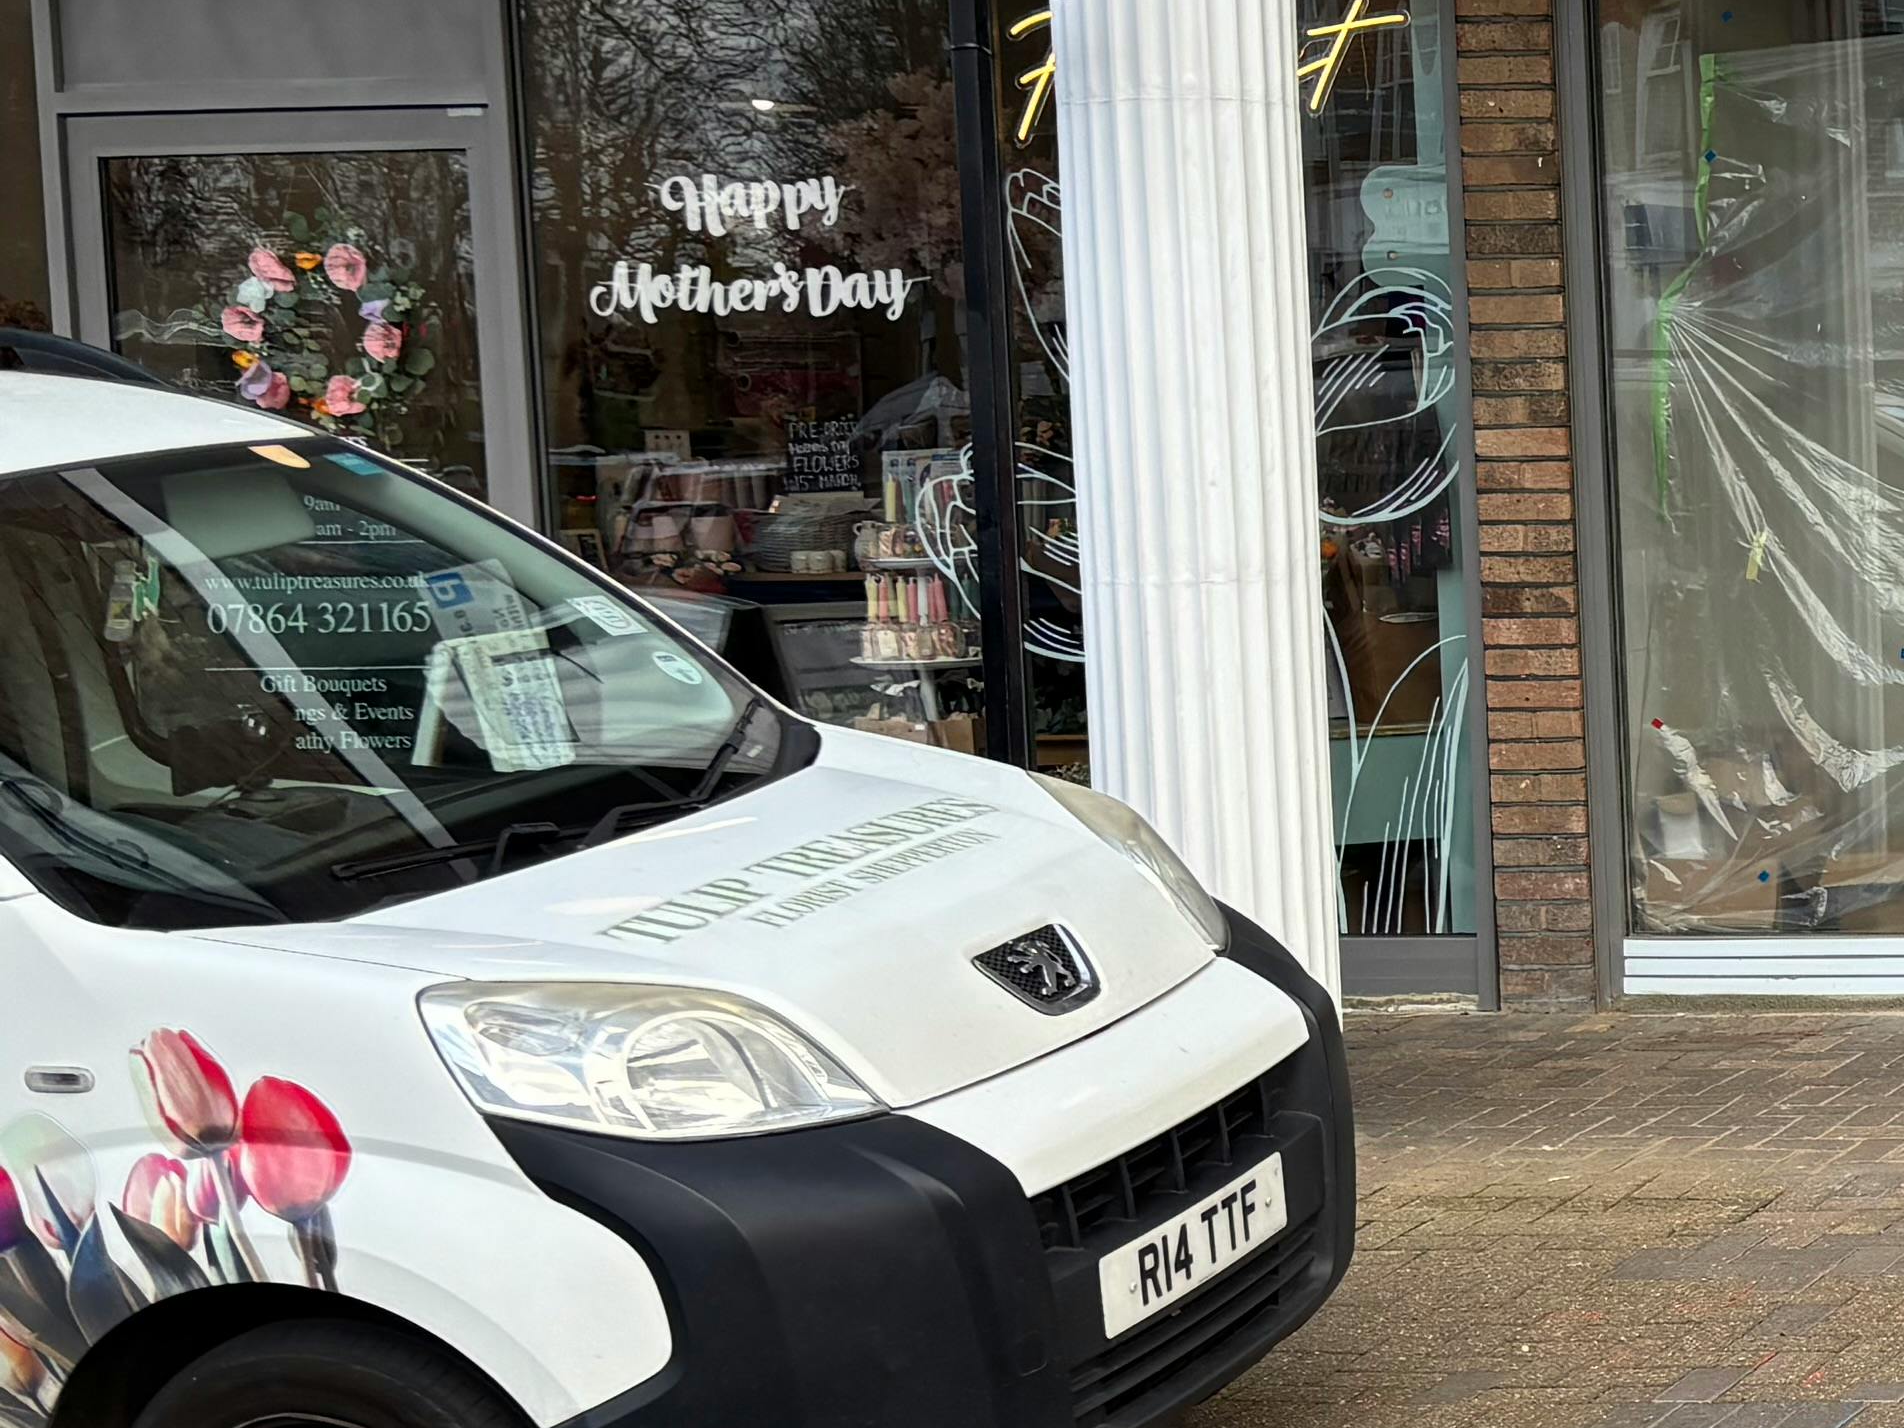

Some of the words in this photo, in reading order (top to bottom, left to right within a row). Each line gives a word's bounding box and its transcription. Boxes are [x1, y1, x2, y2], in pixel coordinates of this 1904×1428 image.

[657, 173, 850, 237] Happy
[805, 264, 915, 320] Day
[792, 454, 860, 473] FLOWERS
[315, 523, 343, 537] am
[359, 520, 397, 540] 2pm
[205, 570, 429, 594] www.tuliptreasures.co.uk
[206, 602, 309, 635] 07864
[317, 600, 433, 635] 321165
[260, 674, 297, 694] Gift
[303, 674, 388, 697] Bouquets
[331, 703, 350, 721] &
[354, 702, 415, 722] Events
[340, 731, 412, 750] Flowers
[594, 877, 771, 944] TULIP
[741, 797, 1001, 879] TREASURES
[747, 879, 863, 929] FLORIST
[844, 828, 1001, 885] SHEPPERTON
[1138, 1223, 1194, 1306] R14
[1201, 1179, 1257, 1264] TTF
